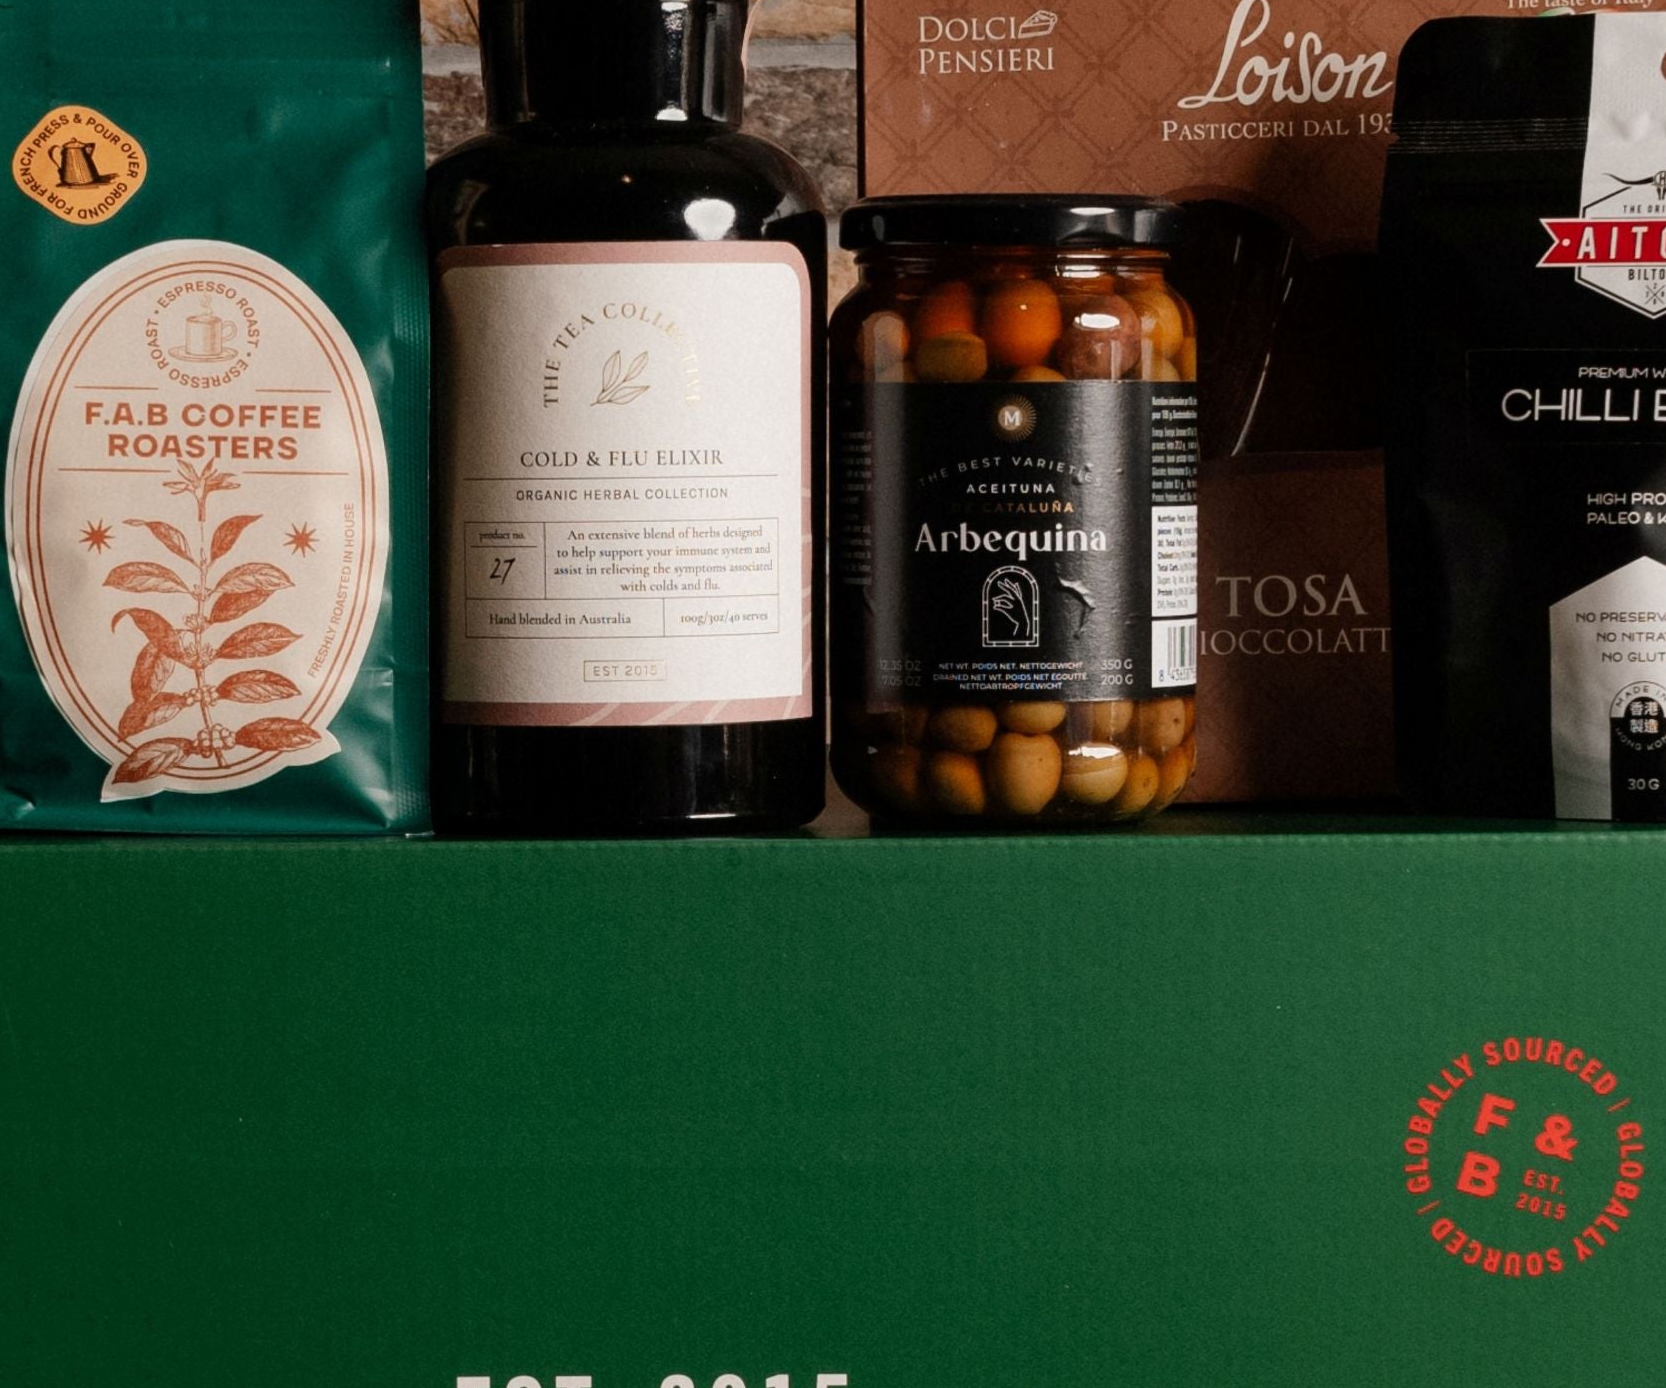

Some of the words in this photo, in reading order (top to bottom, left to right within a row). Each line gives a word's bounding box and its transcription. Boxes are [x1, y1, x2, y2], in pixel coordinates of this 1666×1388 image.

[918, 15, 1017, 44] DOLCI
[918, 47, 1055, 75] PENSIERI
[1161, 118, 1294, 143] PASTICCERI
[1302, 118, 1349, 138] DAL
[1357, 114, 1393, 136] 193
[1578, 367, 1649, 379] PREMIUM
[84, 401, 169, 428] F.A.B
[181, 402, 322, 429] COFFEE
[1501, 387, 1641, 422] CHILLI
[106, 434, 299, 460] ROASTERS
[520, 451, 578, 468] COLD
[586, 451, 601, 468] &
[609, 451, 649, 467] FLU
[656, 450, 724, 467] ELIXIR
[516, 489, 578, 502] ORGANIC
[583, 488, 640, 501] HERBAL
[645, 487, 729, 500] COLLECTION
[966, 483, 1056, 495] ACEITUNA
[1587, 493, 1626, 507] HIGH
[914, 522, 1107, 561] Arbequina
[489, 557, 517, 585] 27
[1215, 574, 1368, 617] TOSA
[593, 666, 620, 677] EST
[625, 665, 659, 676] 2015
[1403, 1053, 1475, 1195] GLOBALLY
[1483, 1037, 1618, 1096] SOURCED
[1473, 1093, 1517, 1136] F
[1534, 1113, 1579, 1161] &
[1456, 1150, 1501, 1198] B
[1523, 1169, 1565, 1196] EST.
[1515, 1192, 1567, 1221] 2015
[1572, 1122, 1646, 1263] GLOBALLY
[1430, 1216, 1565, 1278] SOURCED
